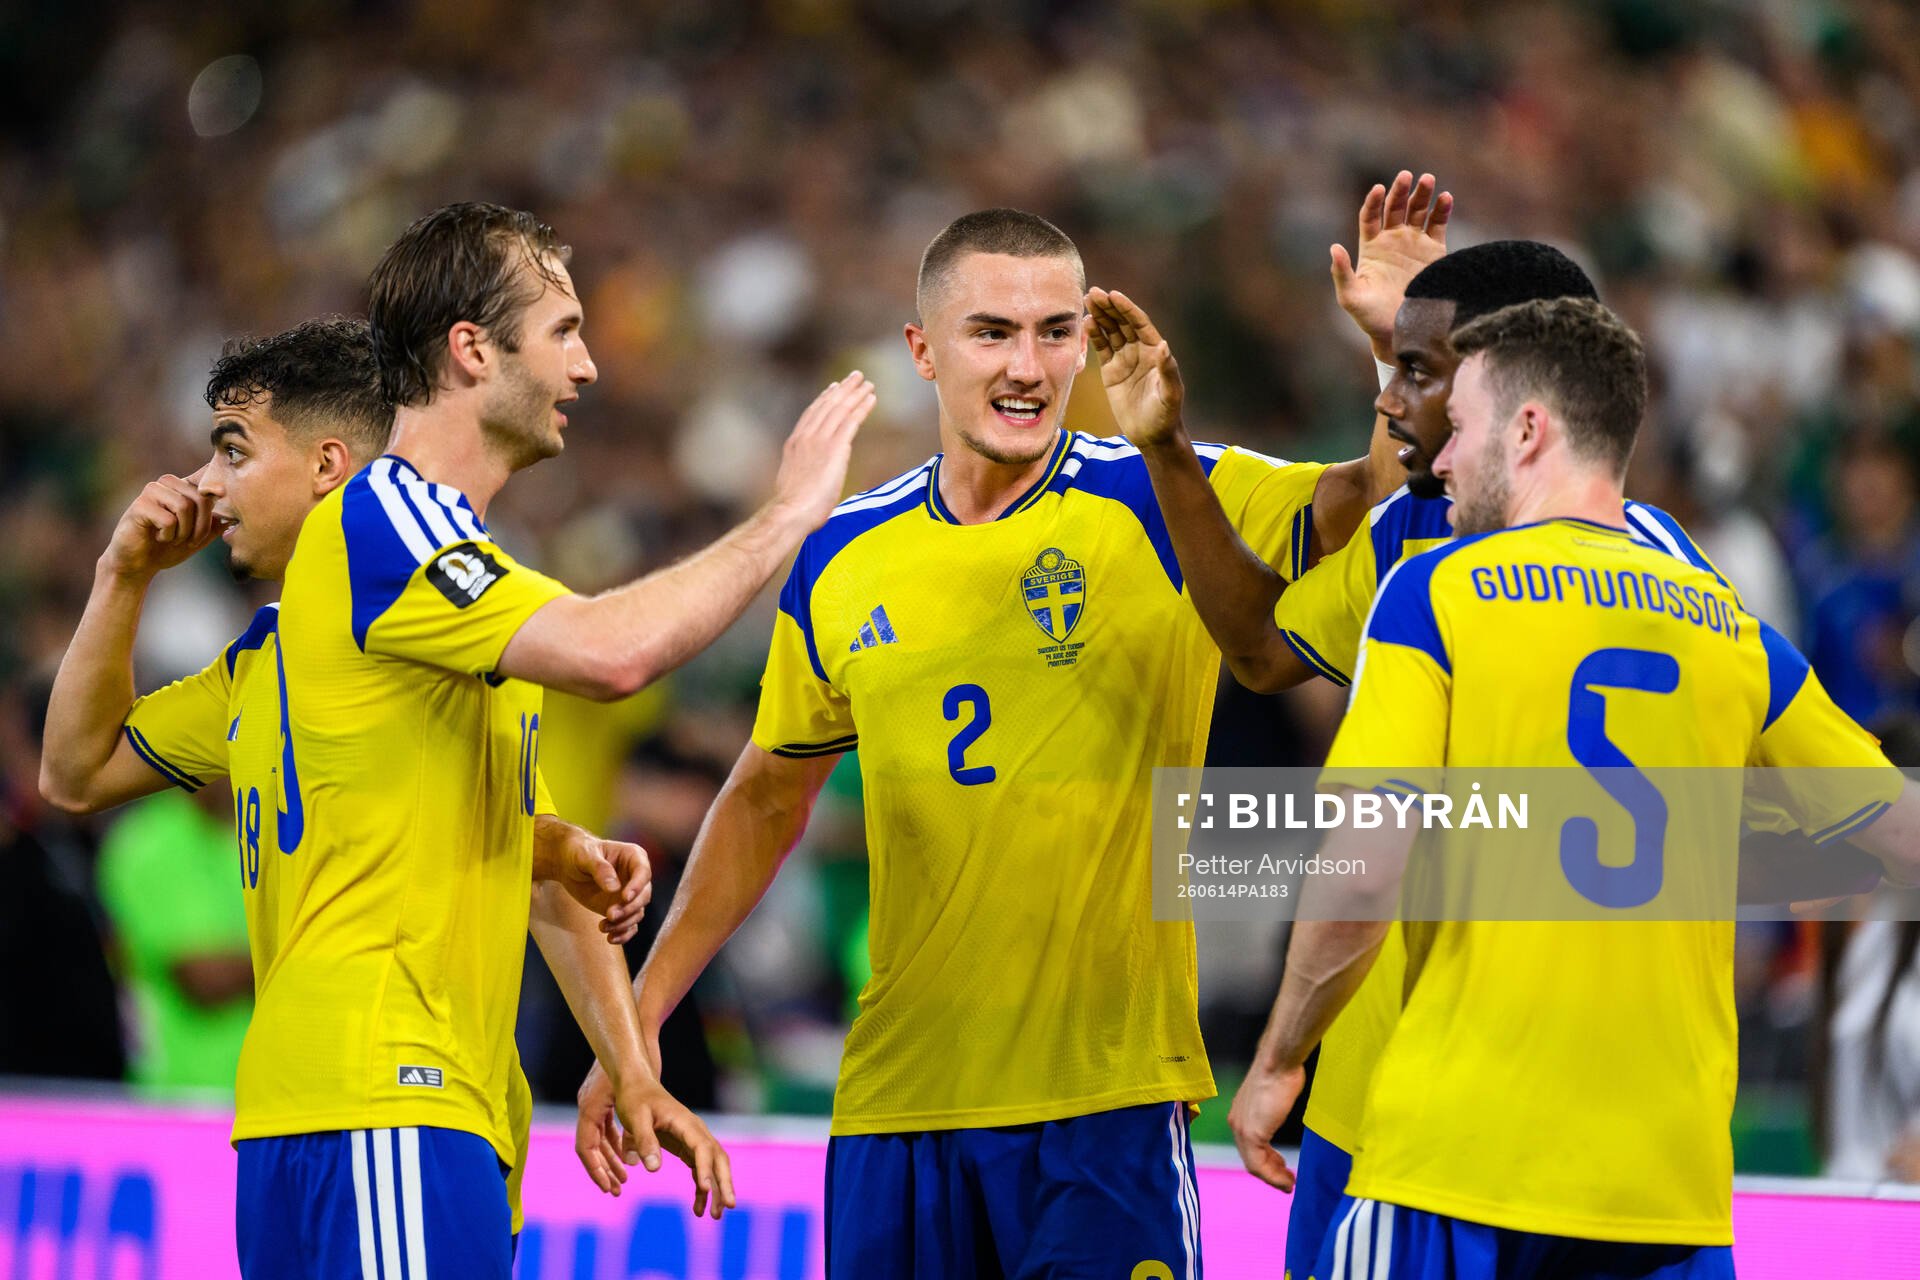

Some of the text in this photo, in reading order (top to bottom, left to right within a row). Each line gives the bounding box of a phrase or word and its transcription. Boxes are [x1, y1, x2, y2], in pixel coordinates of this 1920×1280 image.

[1029, 571, 1075, 585] SVERIGE
[1471, 564, 1739, 641] GUDMUNDSSON
[942, 683, 996, 786] 2
[1559, 647, 1680, 909] 5
